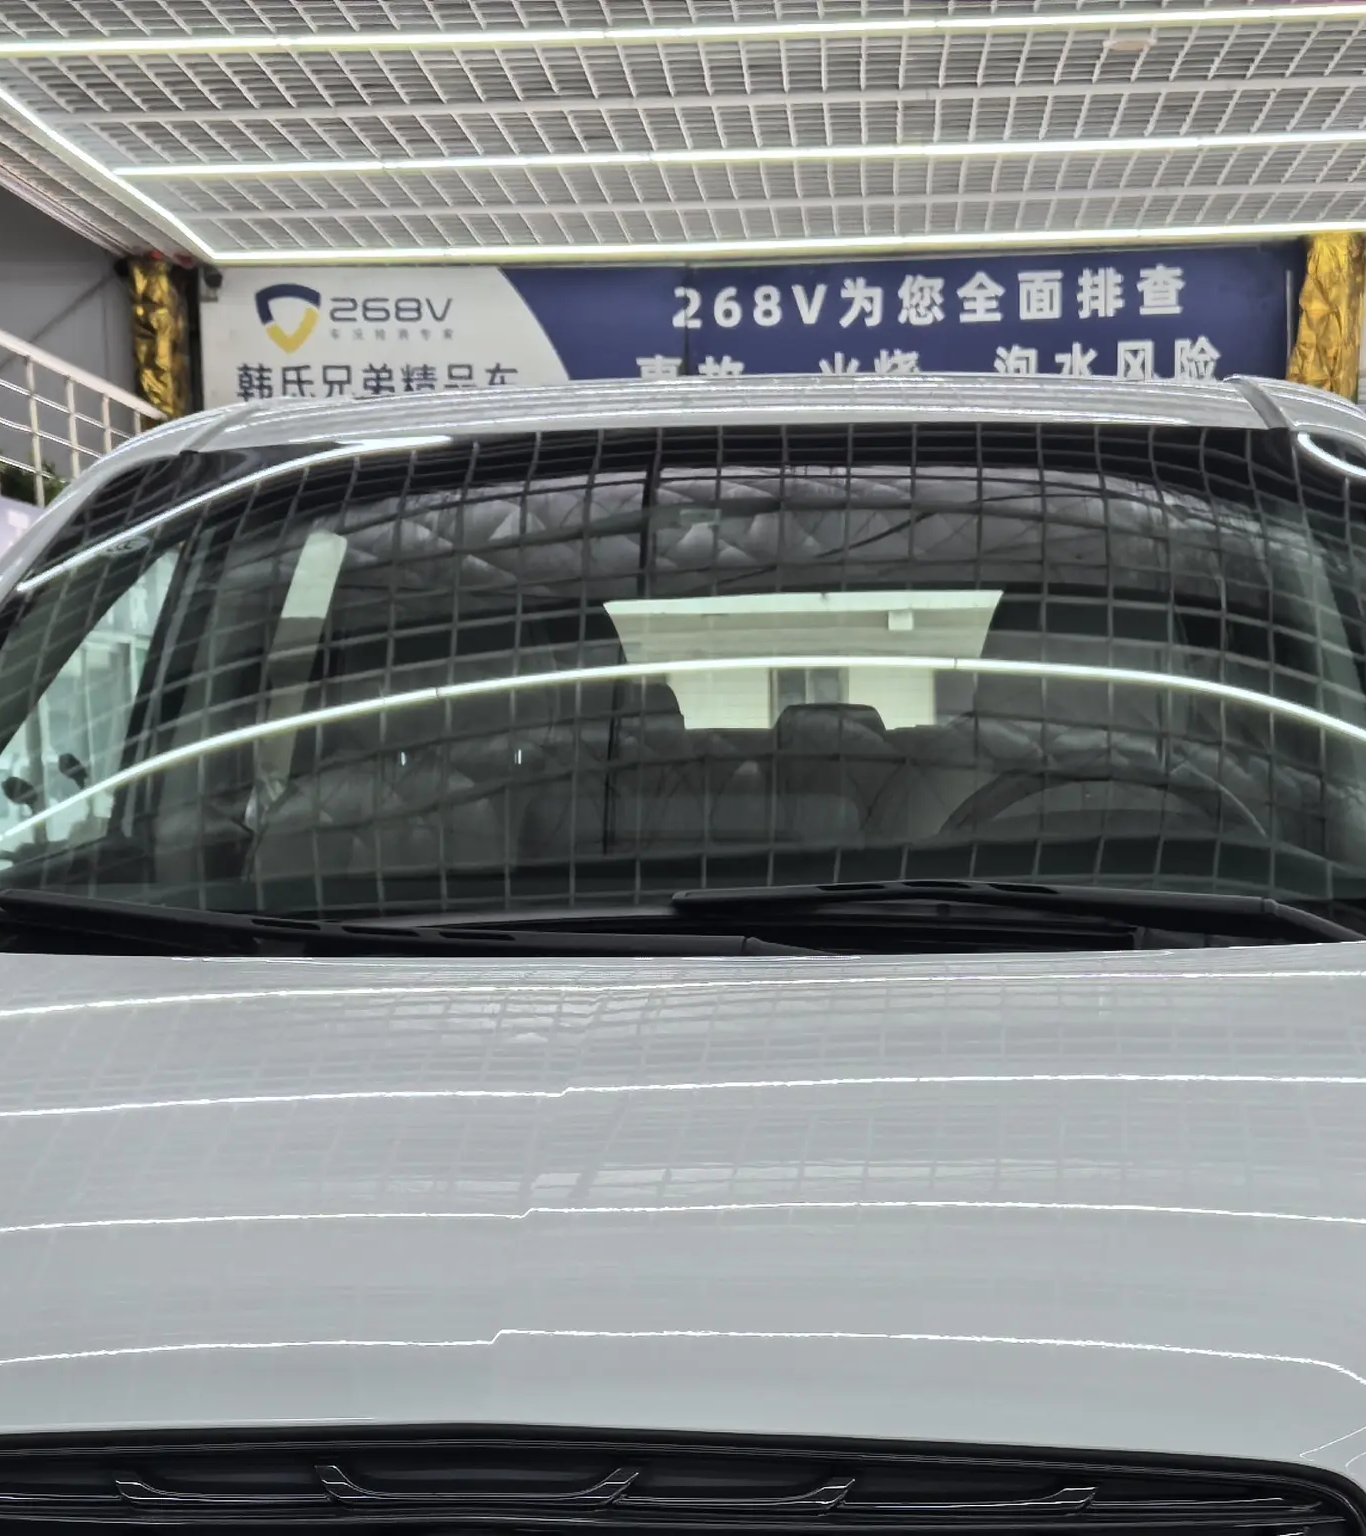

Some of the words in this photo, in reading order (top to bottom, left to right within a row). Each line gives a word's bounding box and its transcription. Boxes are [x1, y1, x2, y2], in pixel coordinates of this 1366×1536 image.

[329, 297, 453, 322] 268V
[671, 263, 1187, 330] 268V为您全面排查
